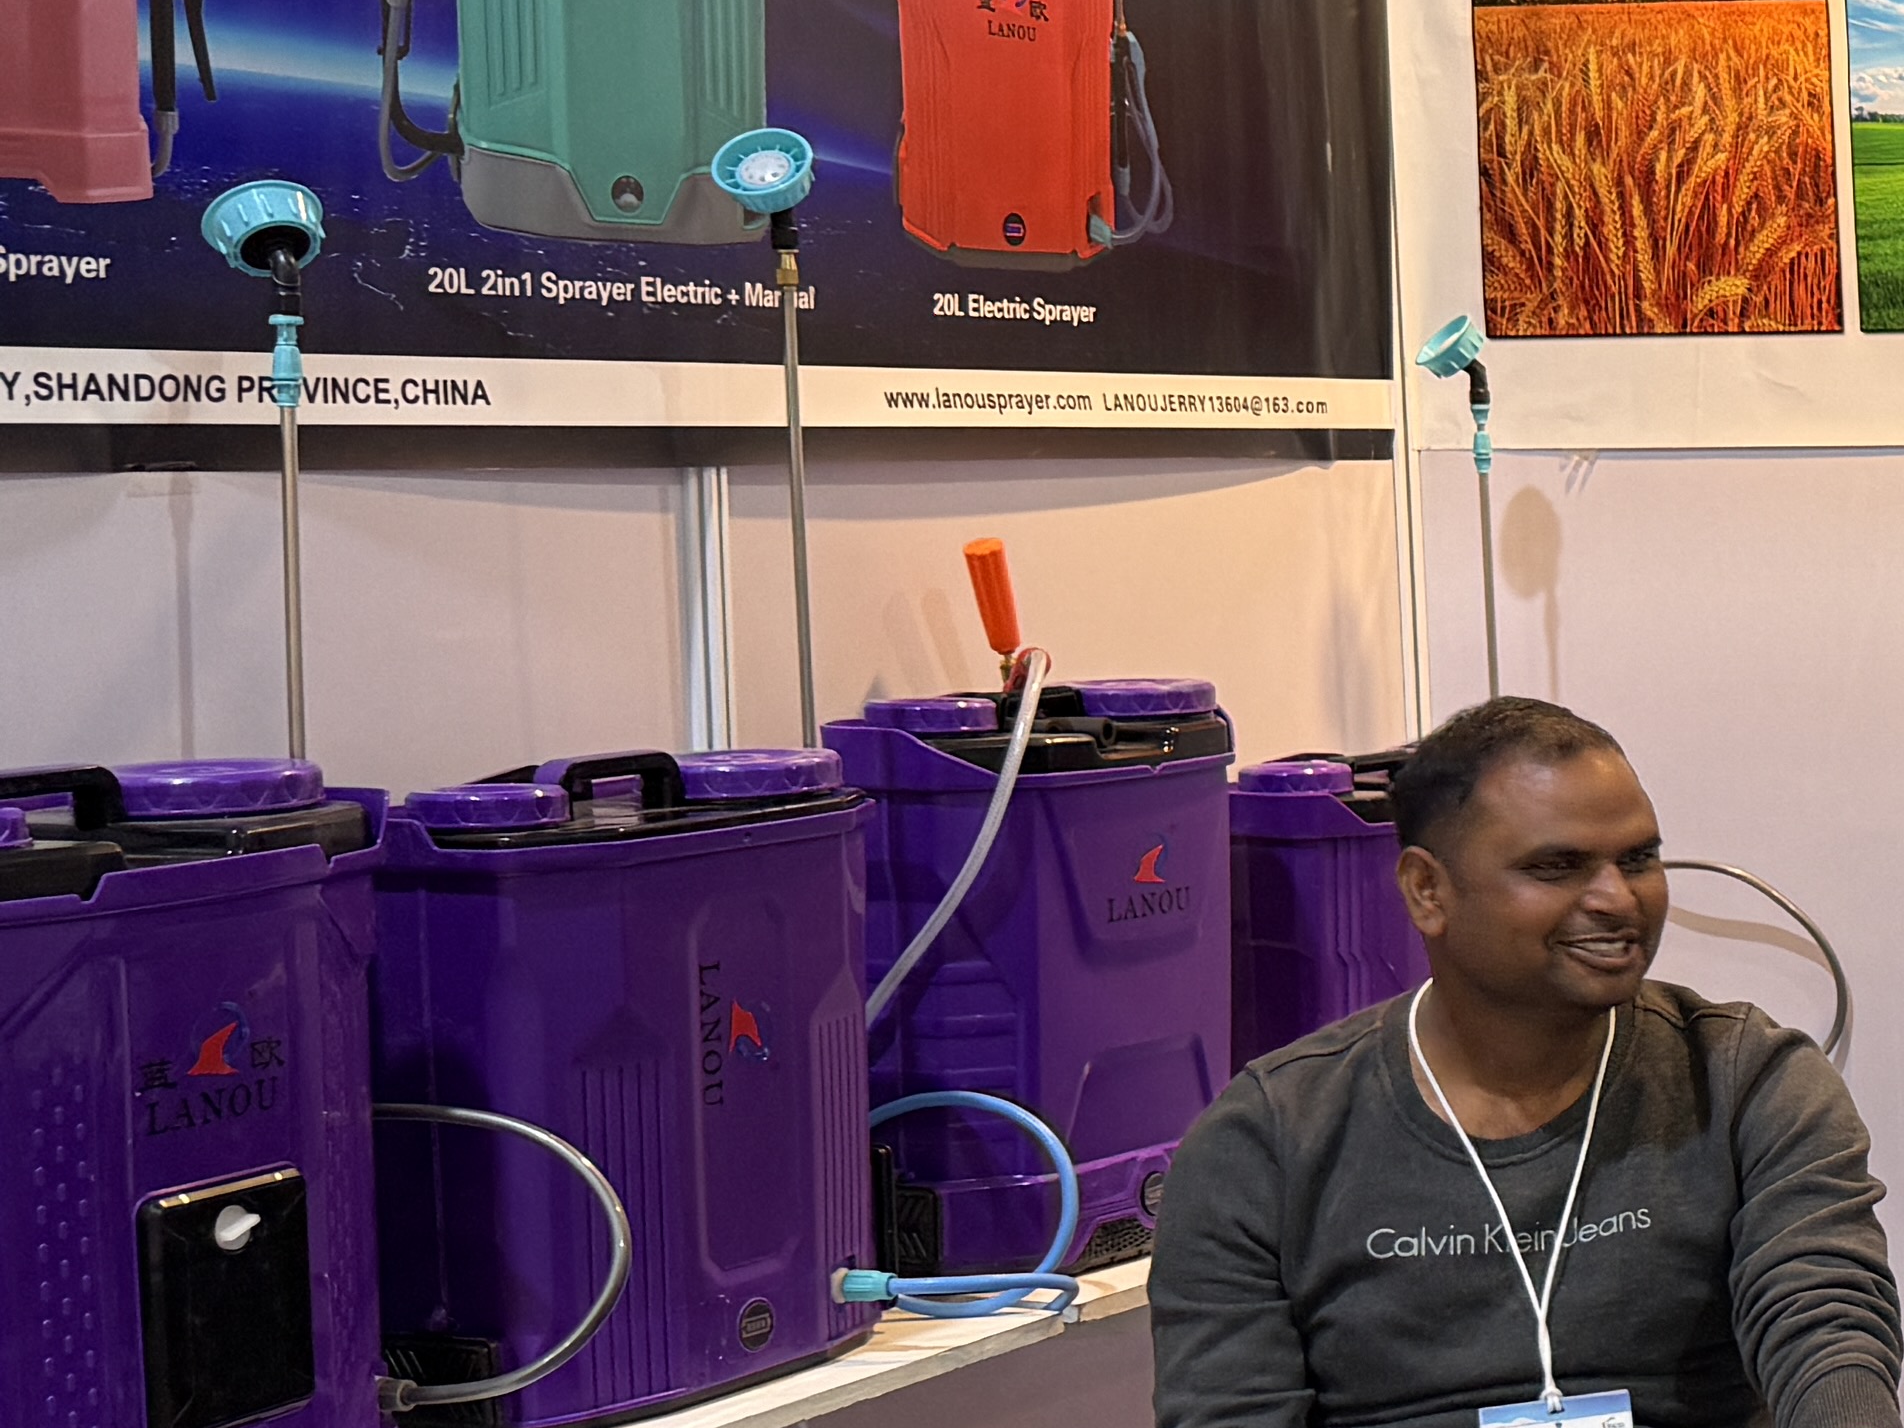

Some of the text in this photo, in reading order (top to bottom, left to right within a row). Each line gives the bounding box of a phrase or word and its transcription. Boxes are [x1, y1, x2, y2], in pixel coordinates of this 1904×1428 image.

[987, 19, 1036, 42] LANOU
[427, 266, 475, 295] 20L
[481, 270, 532, 298] 2in1
[541, 271, 635, 306] Sprayer
[640, 275, 722, 305] Electric
[726, 289, 740, 305] +
[932, 292, 1097, 327] 20L Electric Sprayer
[238, 375, 491, 410] PRVINCE,CHINA
[884, 387, 1328, 417] www.lanousprayer.com LANOUJERRY13604@163.com
[1107, 886, 1190, 923] LANOU
[698, 961, 724, 1106] LANOU
[146, 1075, 278, 1136] LANOU
[1366, 1208, 1651, 1259] Calvin Kein Jeans
